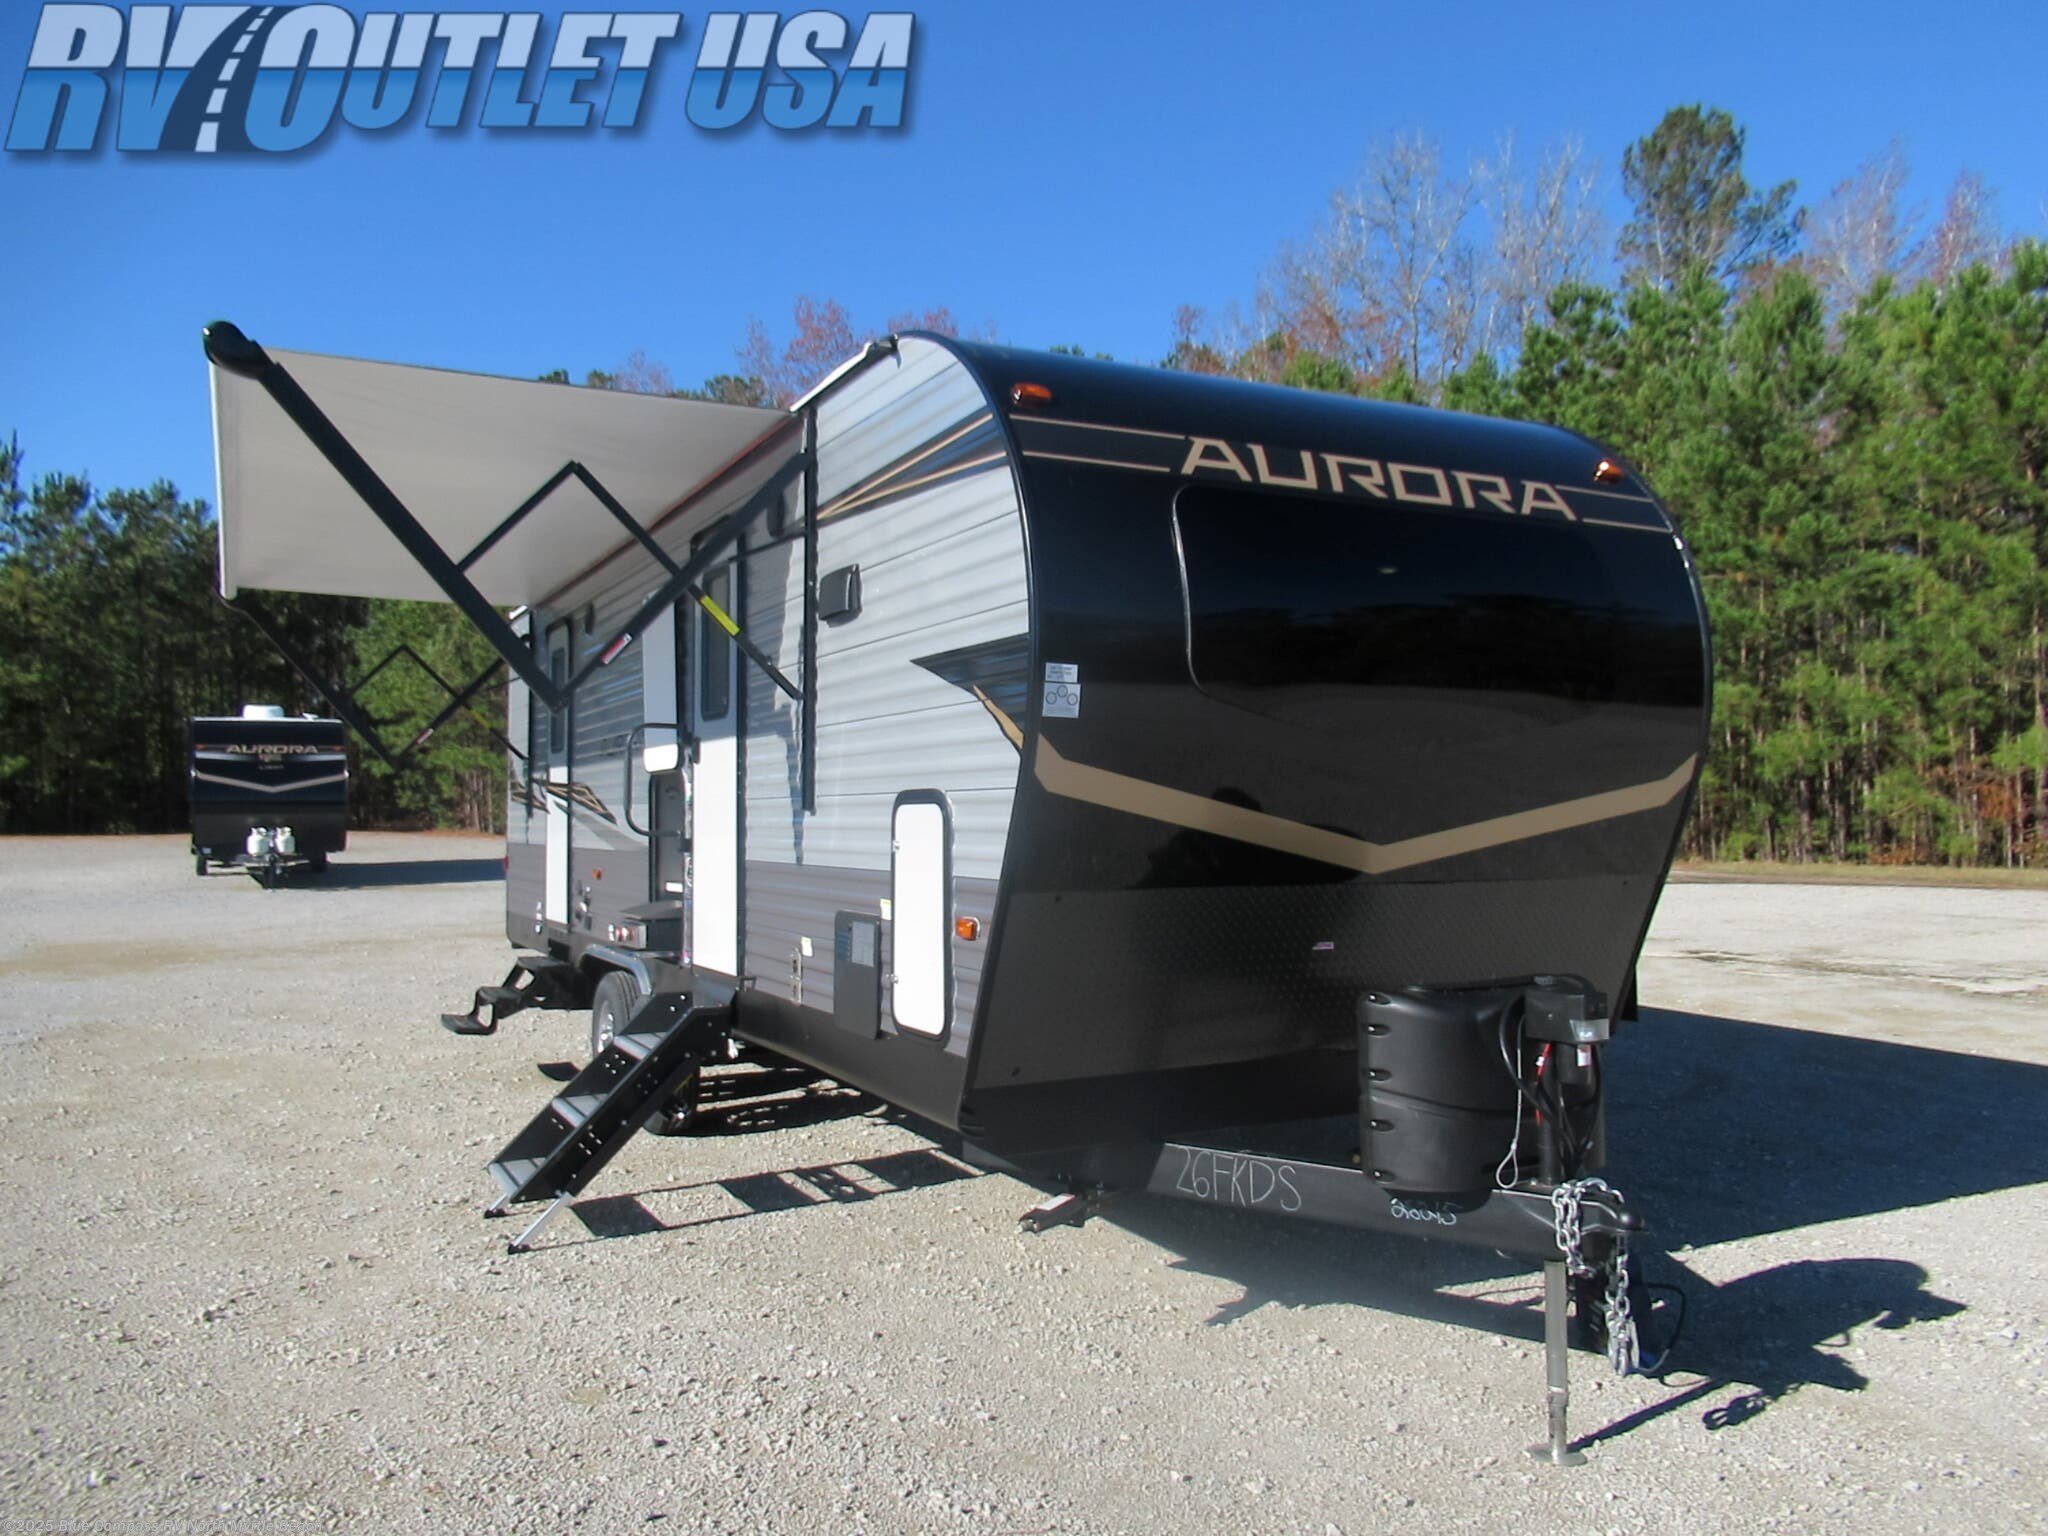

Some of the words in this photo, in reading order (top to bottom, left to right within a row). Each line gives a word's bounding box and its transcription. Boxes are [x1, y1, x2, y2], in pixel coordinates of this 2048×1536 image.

[1181, 435, 1578, 522] AURORA
[226, 744, 318, 754] AURORA
[1176, 1148, 1302, 1211] 26FKDS
